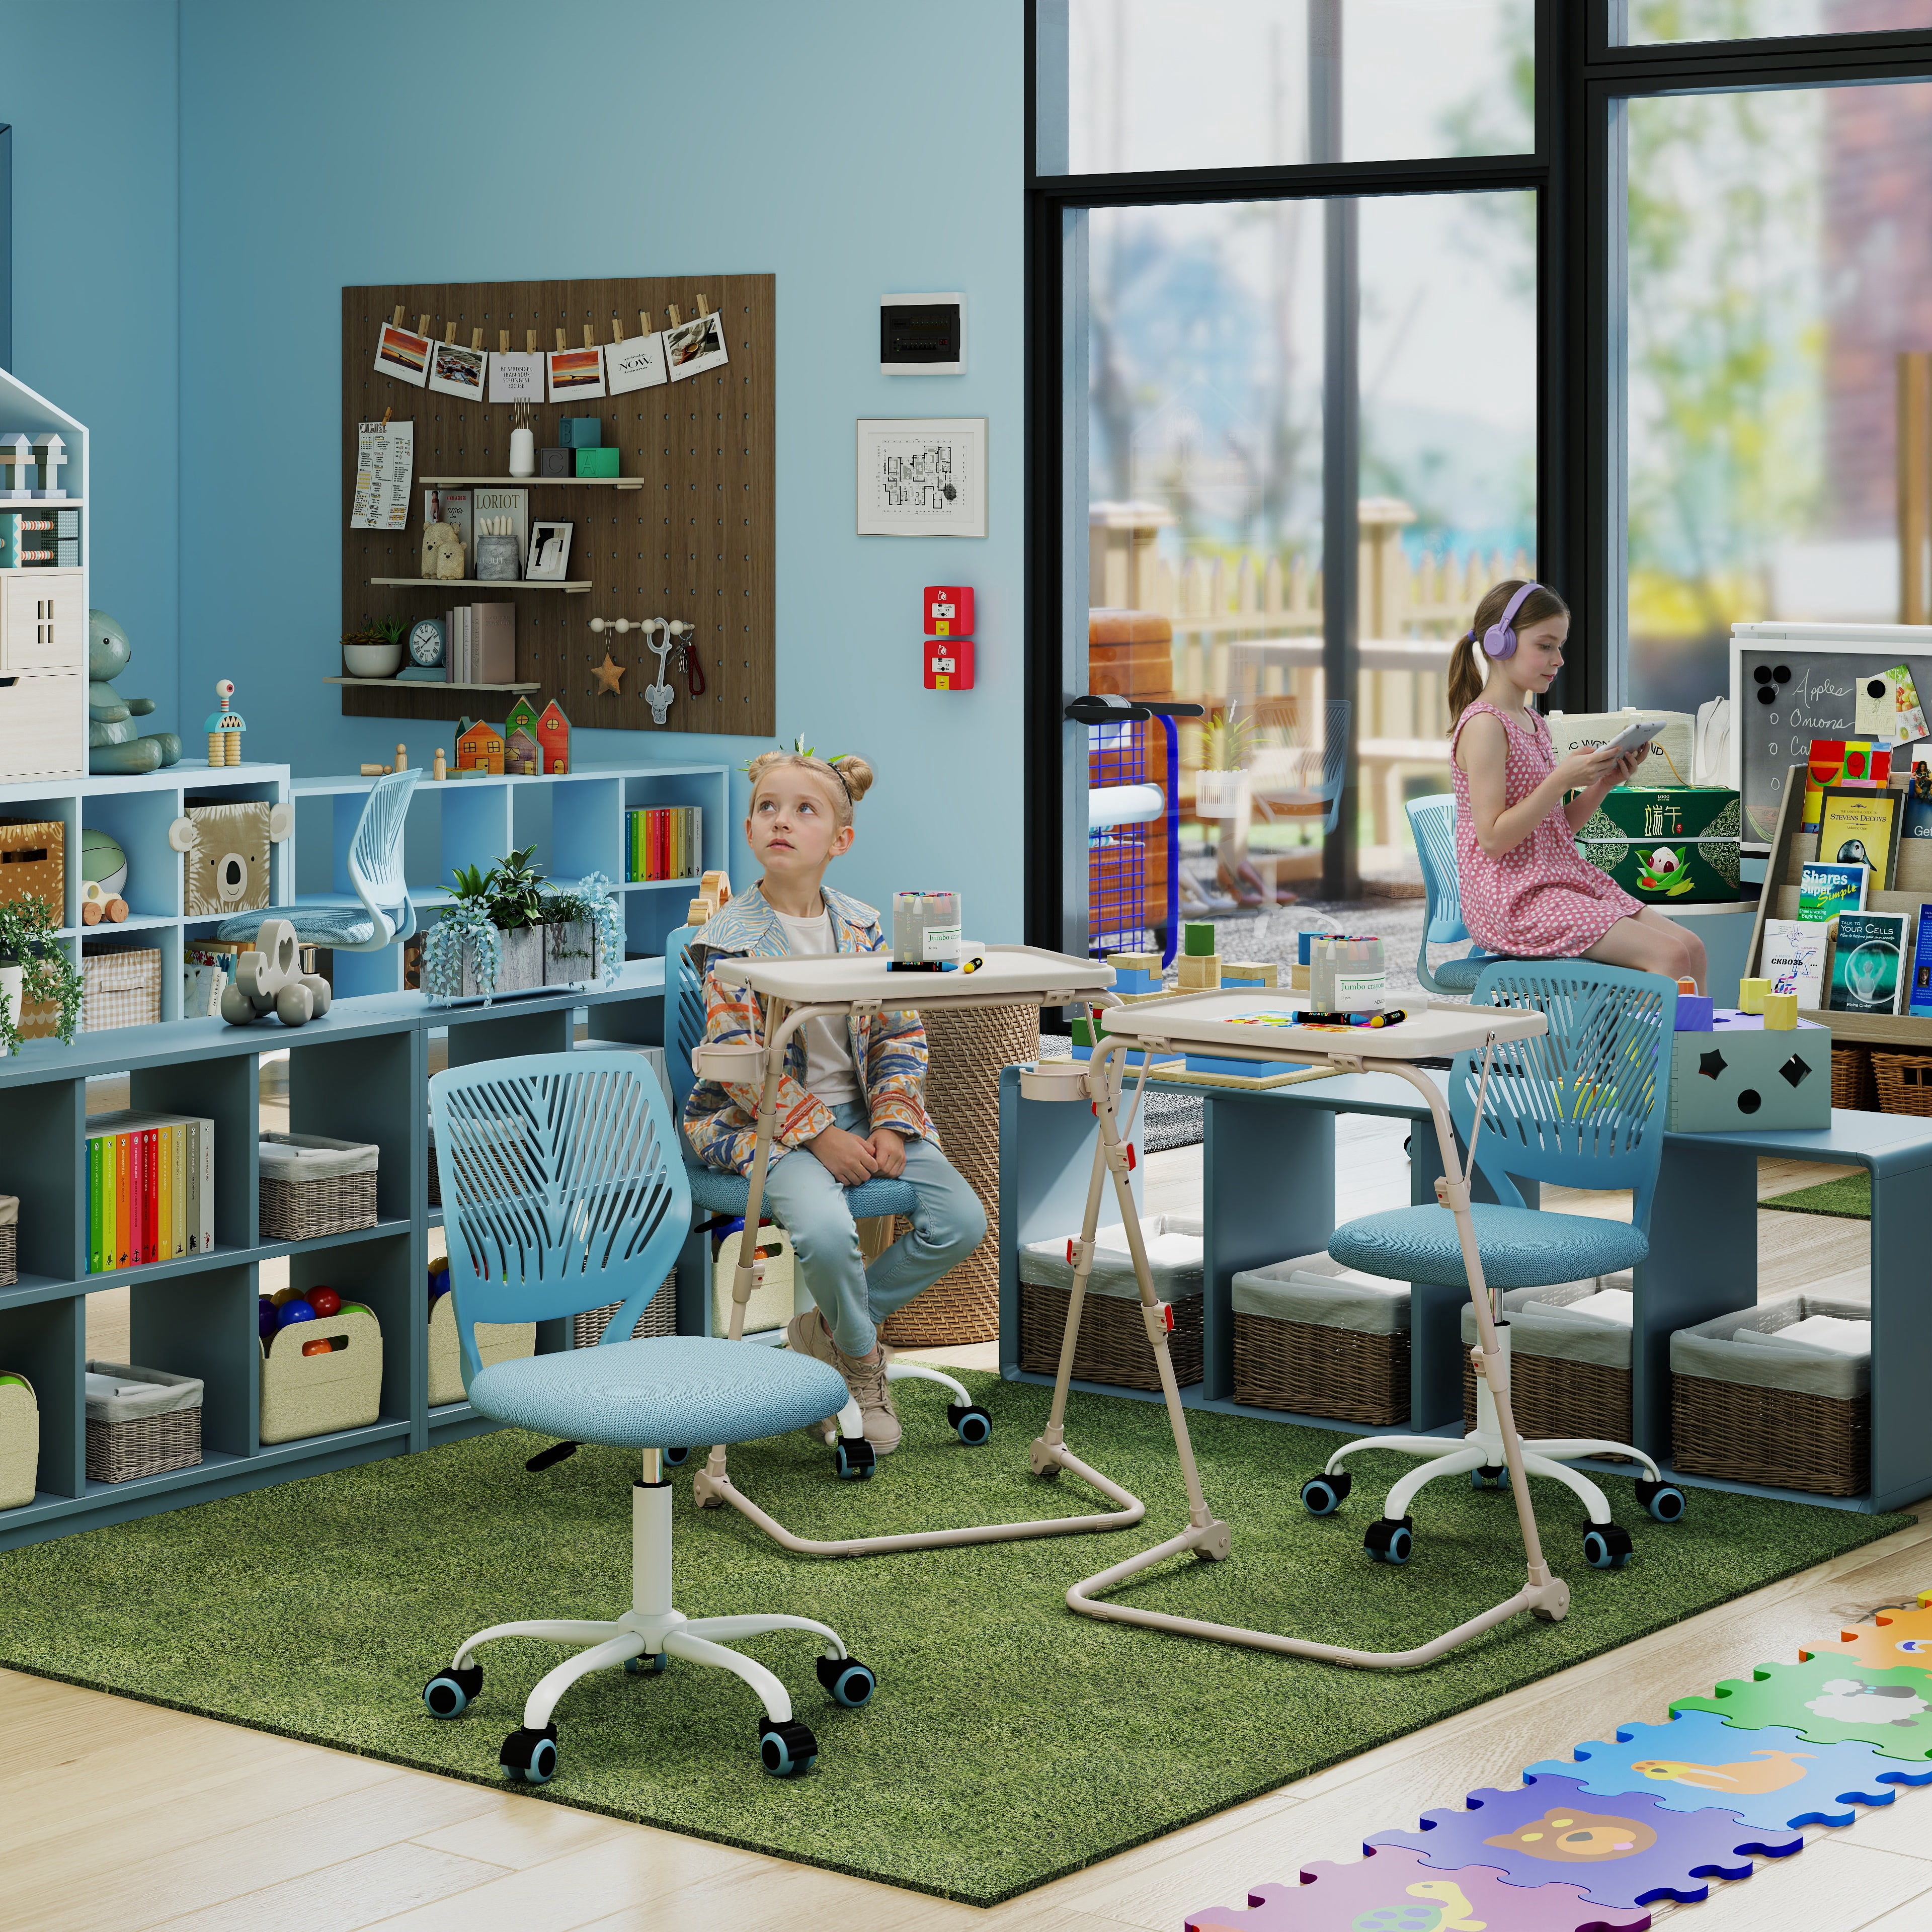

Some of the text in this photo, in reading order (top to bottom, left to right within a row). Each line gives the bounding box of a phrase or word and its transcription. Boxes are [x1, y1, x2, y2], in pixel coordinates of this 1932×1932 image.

[547, 453, 564, 473] C
[581, 453, 595, 474] A
[476, 495, 520, 509] LORIOT
[1792, 668, 1854, 708] Apples
[1790, 708, 1856, 730] Onions
[1802, 869, 1847, 885] Shares
[1800, 883, 1831, 896] Super
[1817, 884, 1857, 907] Simple
[1865, 924, 1894, 935] CELLS
[928, 934, 949, 942] Jumbo
[1341, 983, 1365, 992] Jumbo
